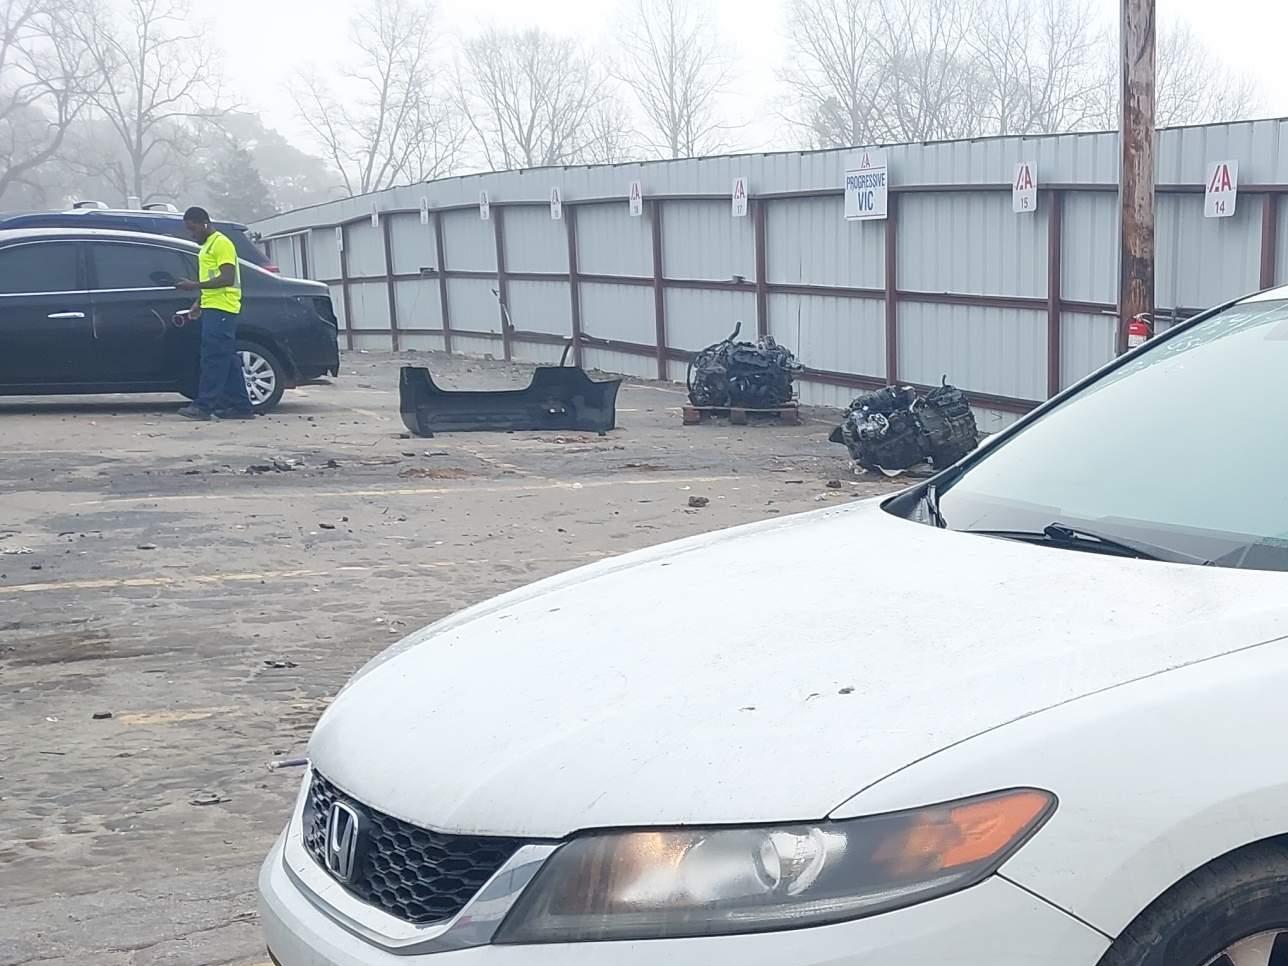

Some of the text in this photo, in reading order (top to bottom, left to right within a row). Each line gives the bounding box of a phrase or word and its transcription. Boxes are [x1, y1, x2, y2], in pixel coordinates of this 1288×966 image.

[846, 173, 886, 191] PROGRESSIVE
[858, 191, 874, 211] VIC
[1216, 200, 1225, 214] 14
